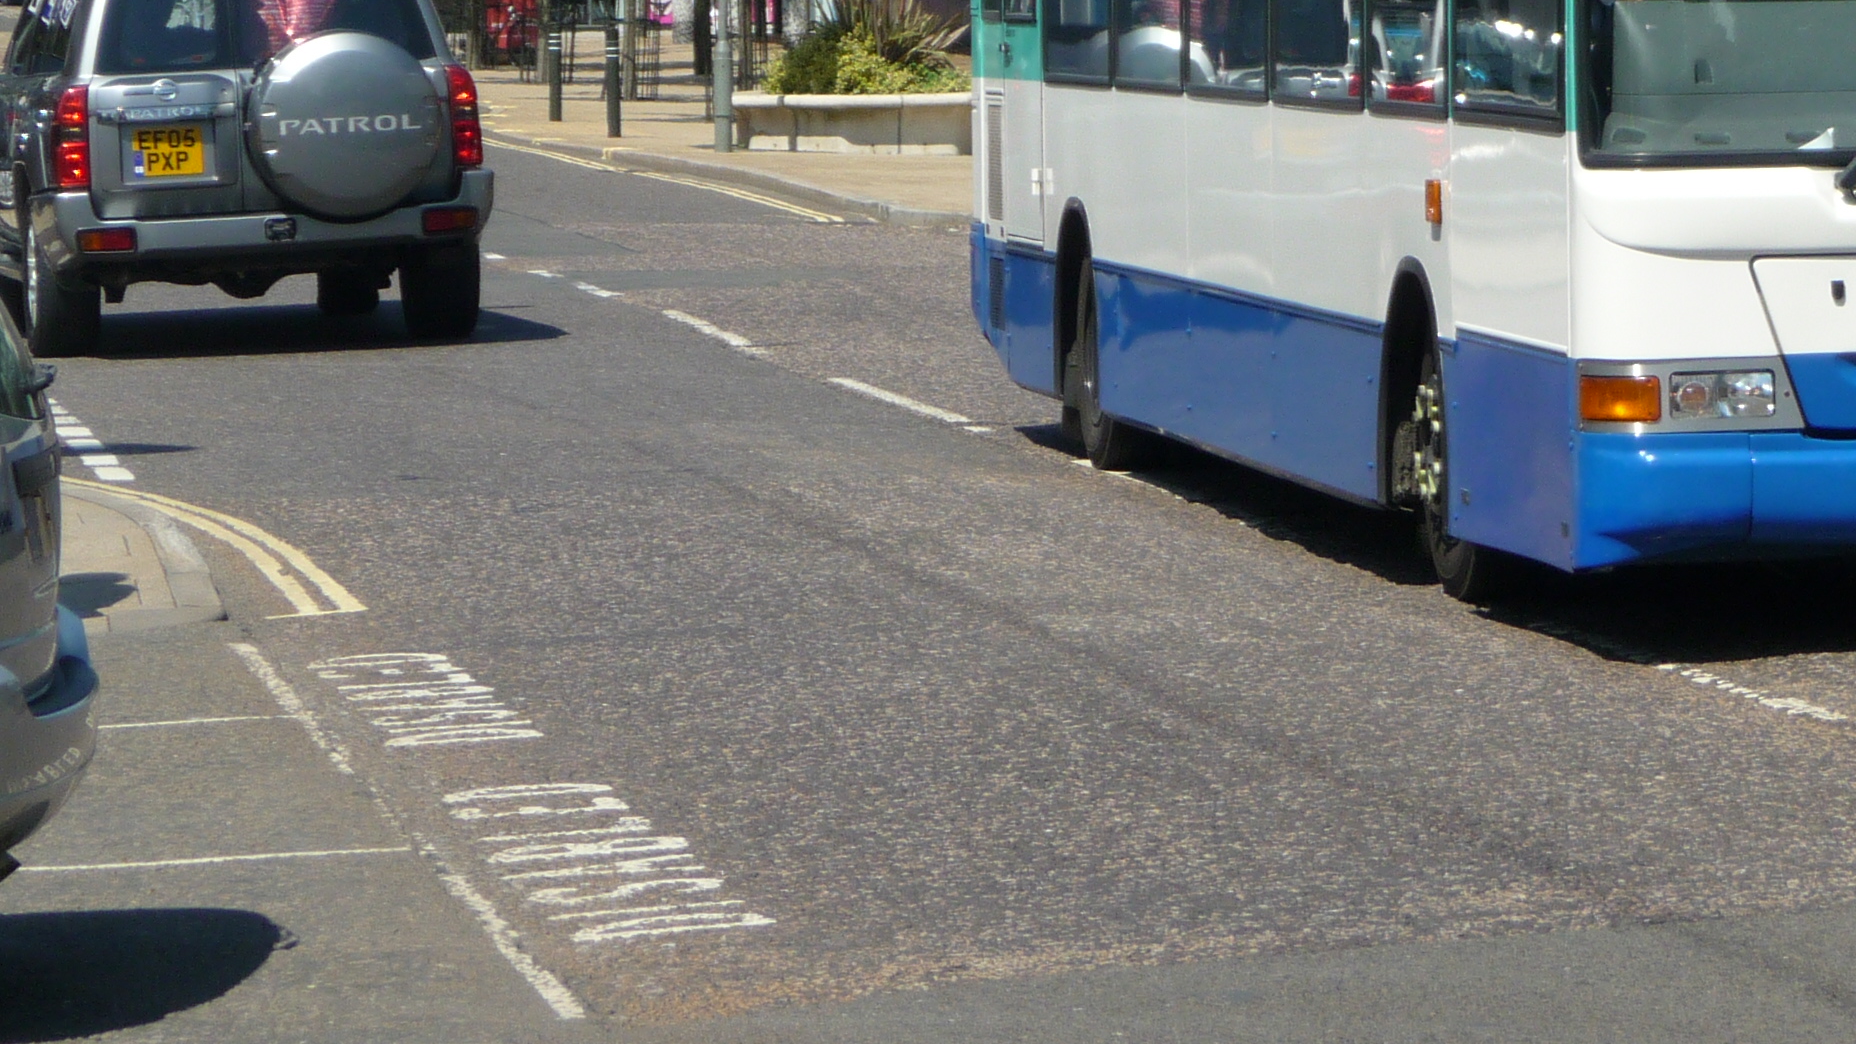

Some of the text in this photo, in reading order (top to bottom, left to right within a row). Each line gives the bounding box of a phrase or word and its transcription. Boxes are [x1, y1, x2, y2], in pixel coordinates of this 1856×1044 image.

[279, 114, 422, 136] PATROL
[138, 128, 196, 150] EF05
[147, 151, 189, 172] PXP
